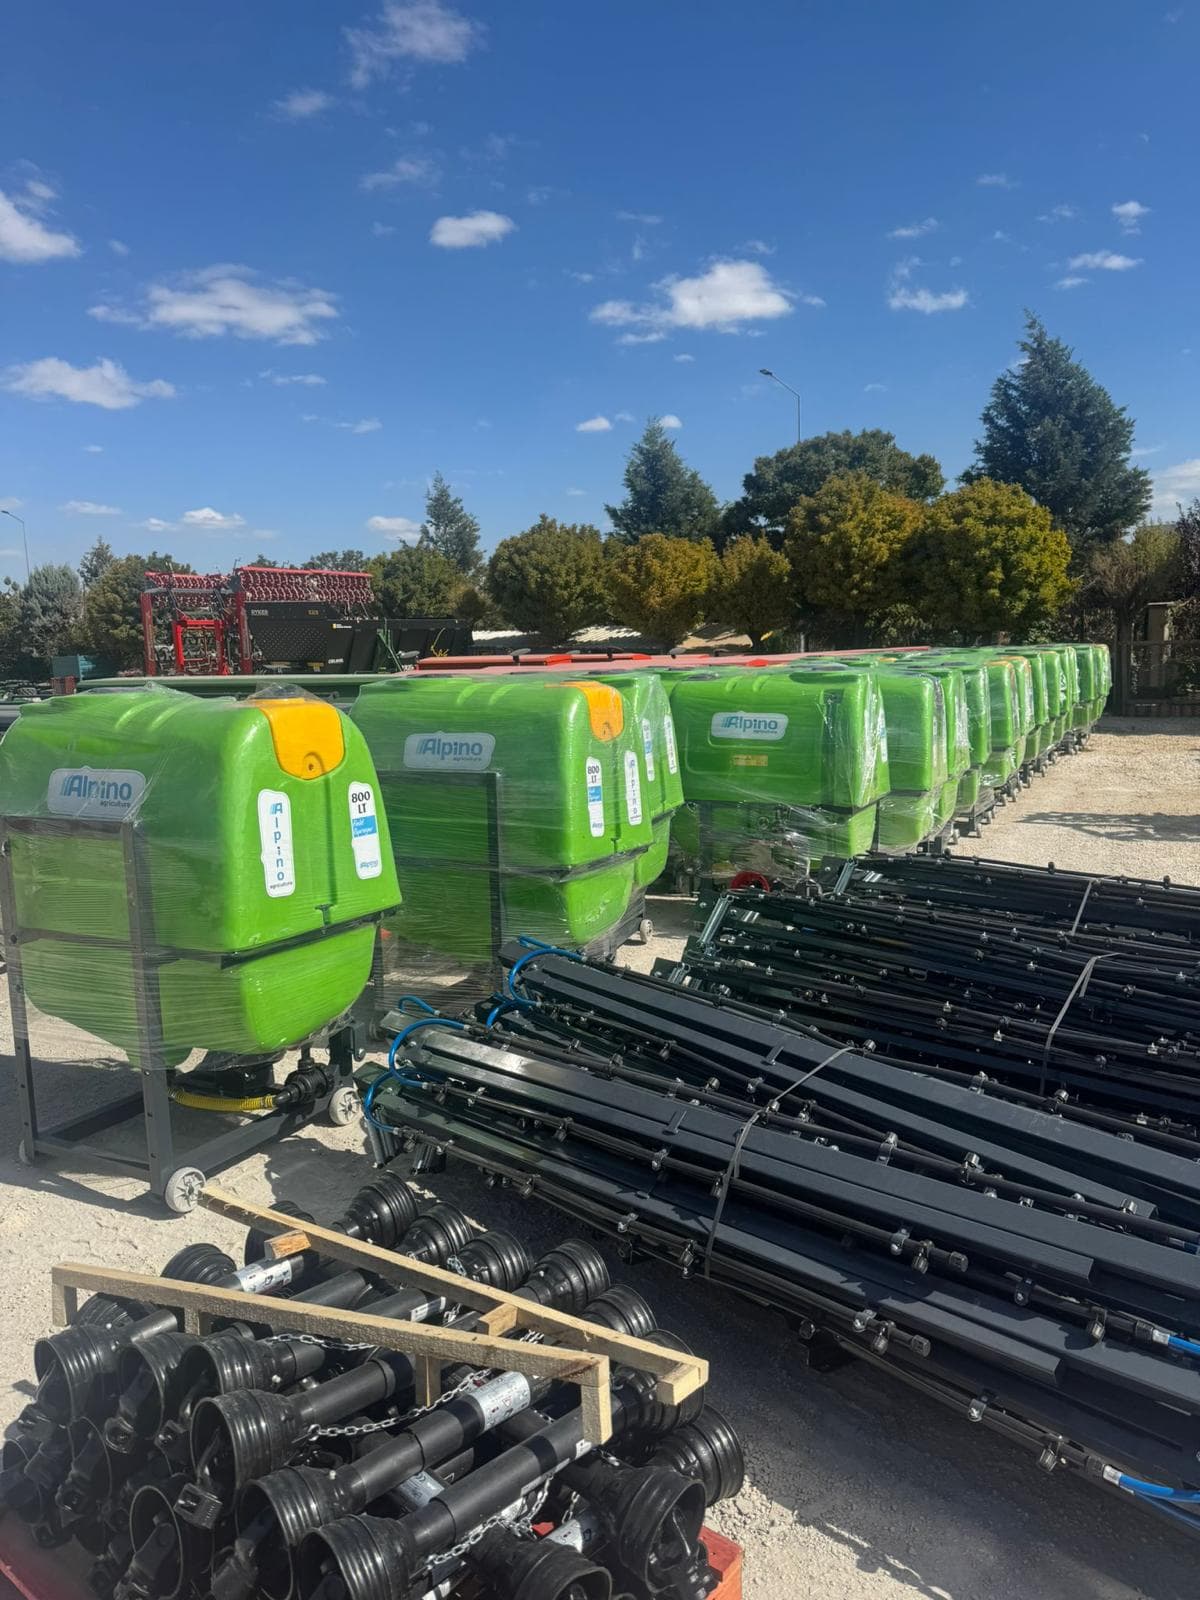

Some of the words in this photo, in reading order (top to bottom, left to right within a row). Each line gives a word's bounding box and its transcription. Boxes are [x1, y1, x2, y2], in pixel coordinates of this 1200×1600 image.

[722, 716, 778, 732] Alpino
[416, 738, 483, 760] Alpino
[352, 791, 370, 803] 800
[270, 803, 285, 880] Alpino
